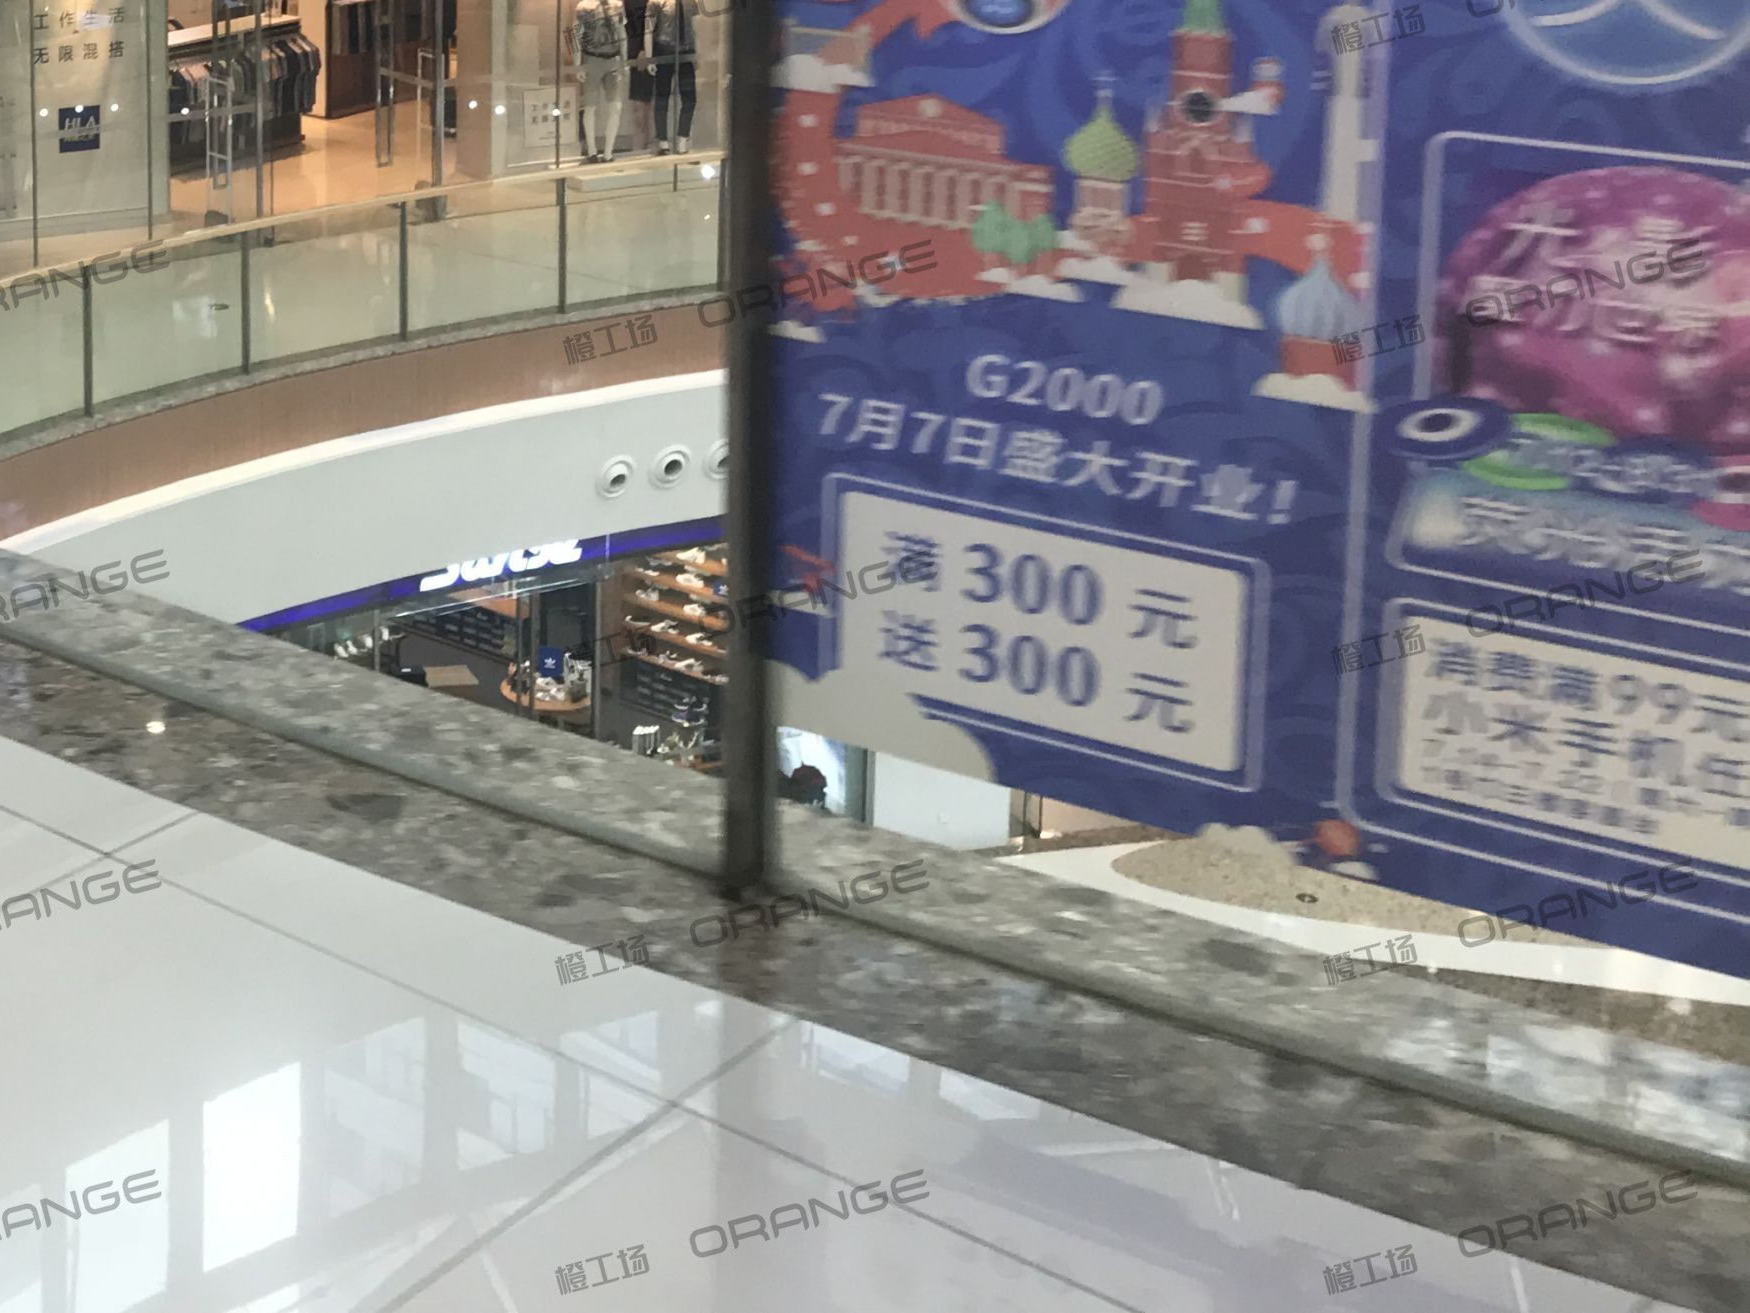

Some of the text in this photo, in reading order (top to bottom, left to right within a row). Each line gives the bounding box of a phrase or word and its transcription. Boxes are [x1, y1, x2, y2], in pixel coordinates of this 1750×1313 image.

[33, 6, 125, 31] 工作生活
[33, 40, 125, 65] 无限混搭
[965, 353, 1165, 426] G2000
[880, 530, 1199, 650] 满 300 元
[877, 609, 1197, 734] 送 300 元
